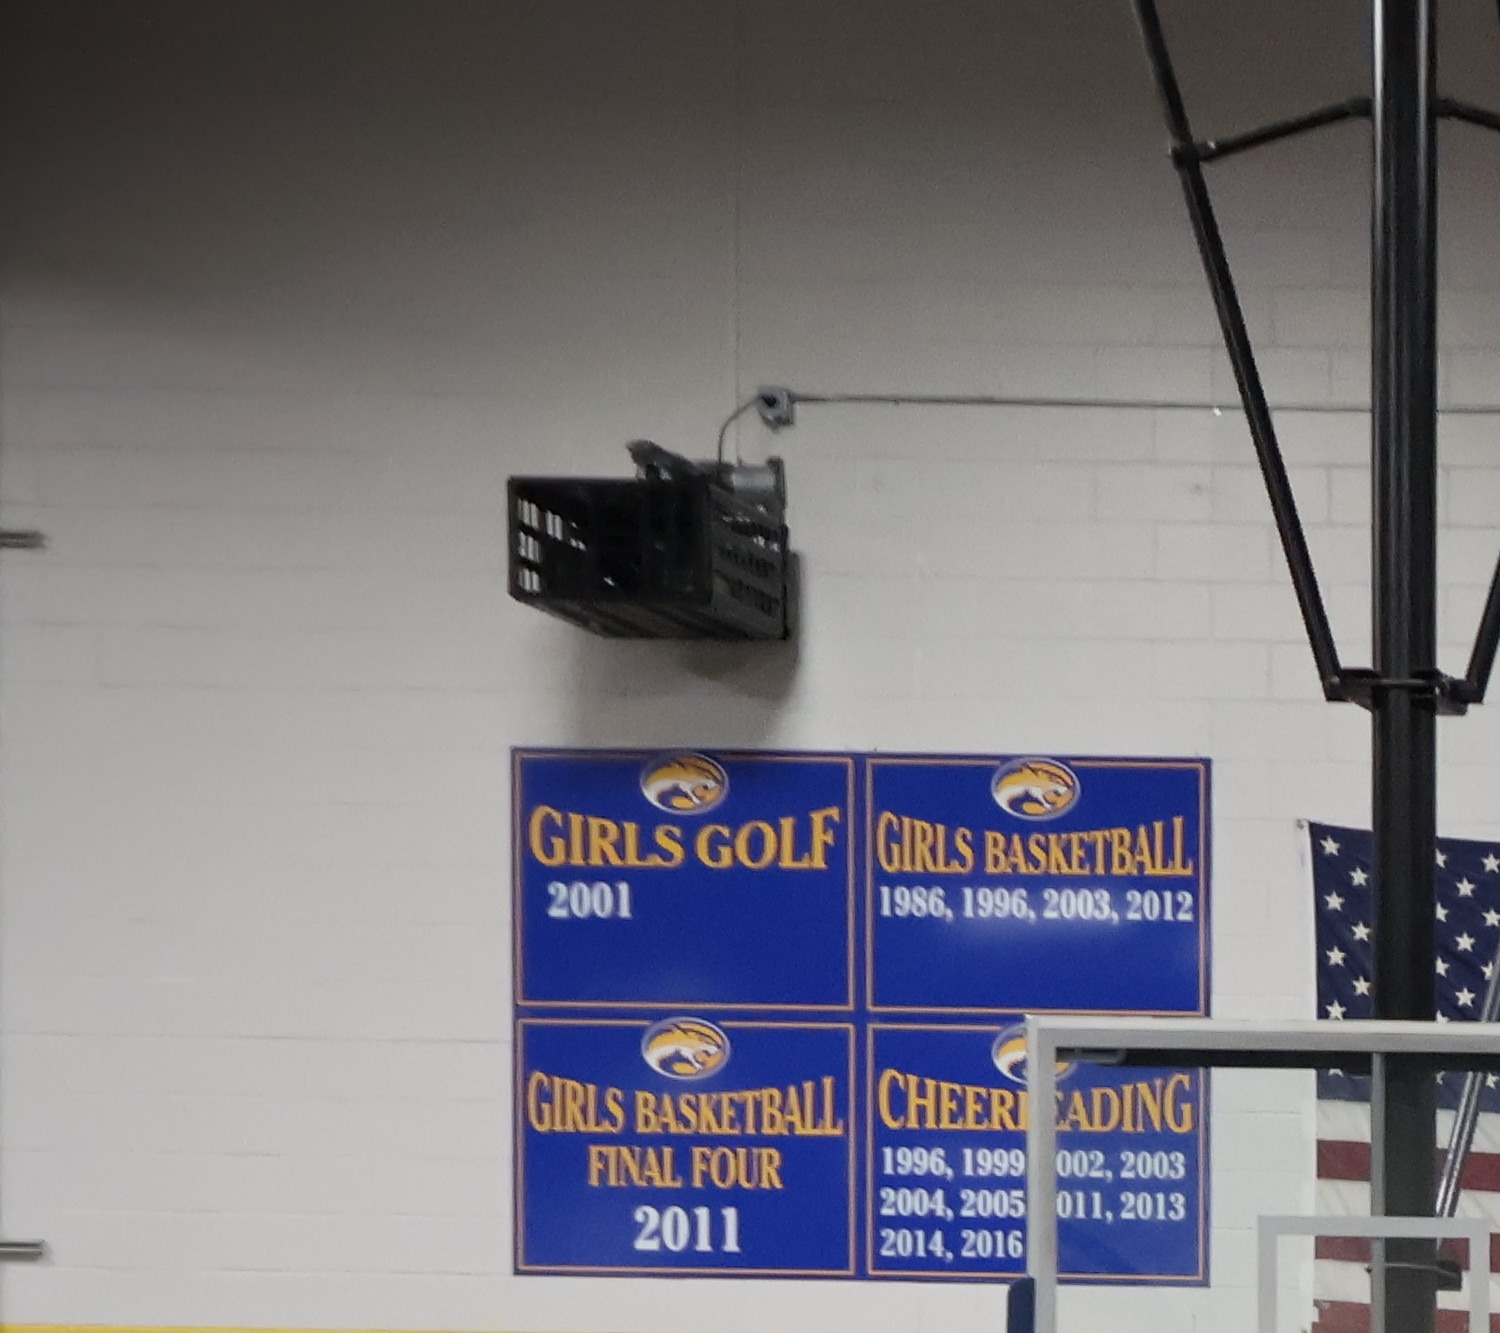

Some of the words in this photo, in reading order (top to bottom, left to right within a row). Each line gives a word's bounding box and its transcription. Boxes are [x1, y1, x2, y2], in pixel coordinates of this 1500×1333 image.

[529, 806, 685, 867] GIRLS
[695, 806, 840, 870] GOLF
[876, 811, 974, 874] GIRLS
[984, 816, 1193, 876] BASKETBALL
[548, 882, 631, 918] 2001
[880, 886, 954, 922] 1986,
[963, 888, 1037, 923] 1996,
[1042, 889, 1119, 924] 2003,
[1125, 890, 1193, 921] 2012
[527, 1071, 626, 1134] GIRLS
[635, 1076, 844, 1136] BASKETBALL
[589, 1145, 682, 1188] FINAL
[692, 1147, 783, 1189] FOUR
[883, 1147, 954, 1181] 1996,
[1120, 1151, 1185, 1179] 2003
[880, 1187, 954, 1221] 2004,
[1120, 1192, 1185, 1221] 2013
[634, 1206, 739, 1252] 2011
[880, 1228, 953, 1262] 2014,
[961, 1230, 1023, 1258] 2016
